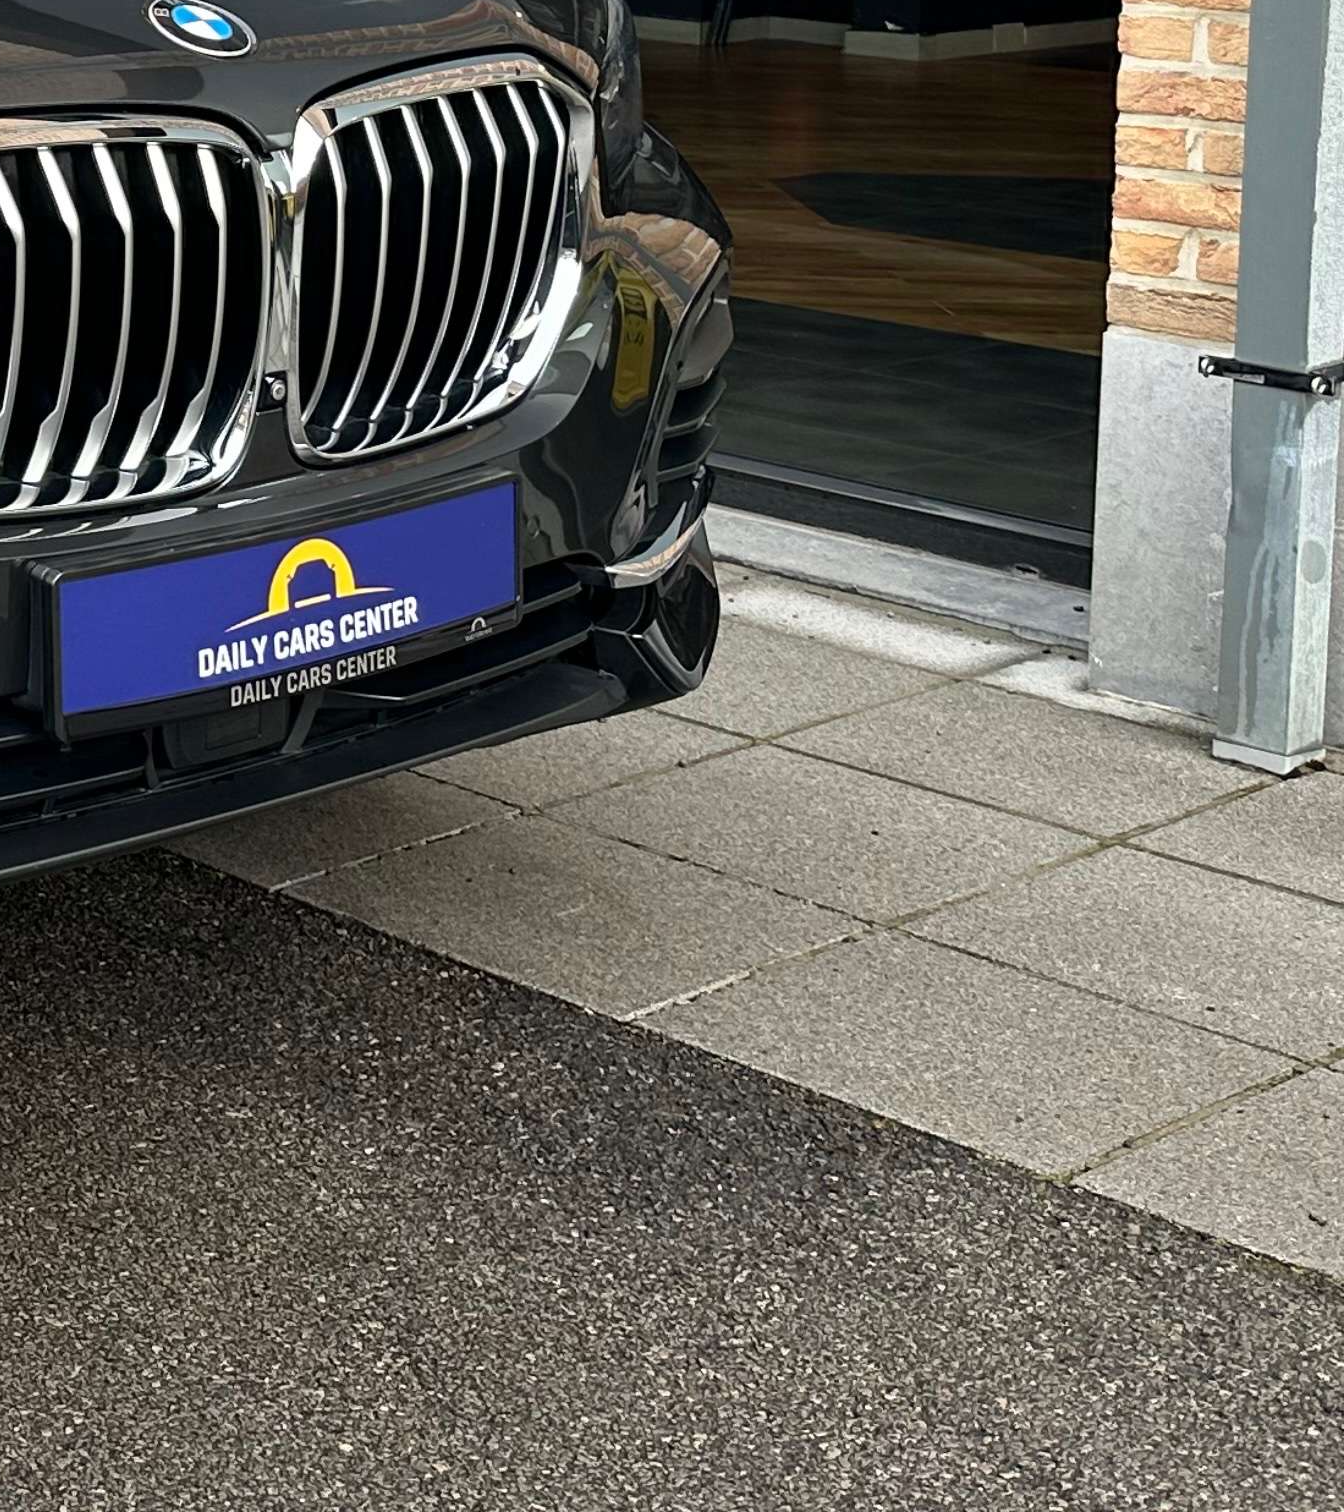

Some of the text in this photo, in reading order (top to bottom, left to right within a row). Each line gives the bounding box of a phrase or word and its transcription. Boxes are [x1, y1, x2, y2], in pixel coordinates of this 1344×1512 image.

[198, 596, 419, 678] DAILY CARS CENTER
[230, 646, 397, 707] DAILY CARS CENTER
